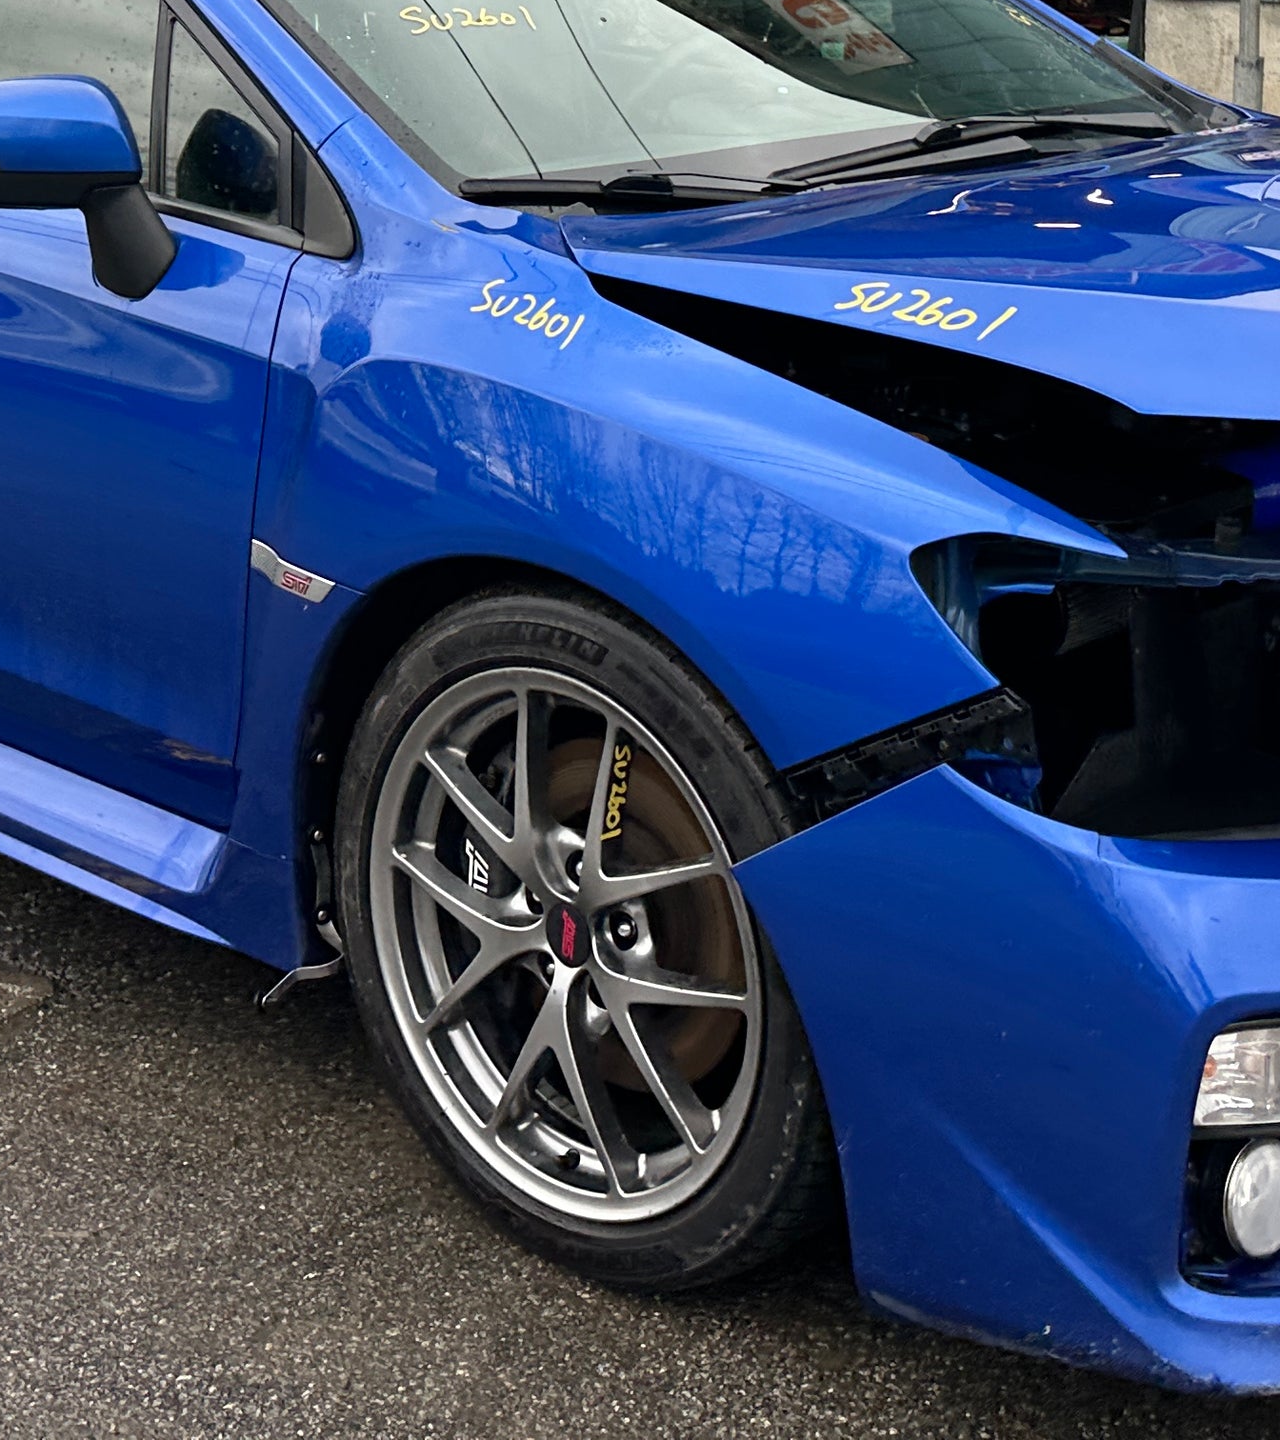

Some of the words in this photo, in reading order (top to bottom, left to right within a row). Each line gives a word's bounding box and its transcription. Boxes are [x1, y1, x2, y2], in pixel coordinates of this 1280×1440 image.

[399, 5, 537, 35] SU2601
[470, 279, 585, 350] SU2601
[834, 281, 1018, 342] SU2601
[600, 744, 631, 841] SU2601
